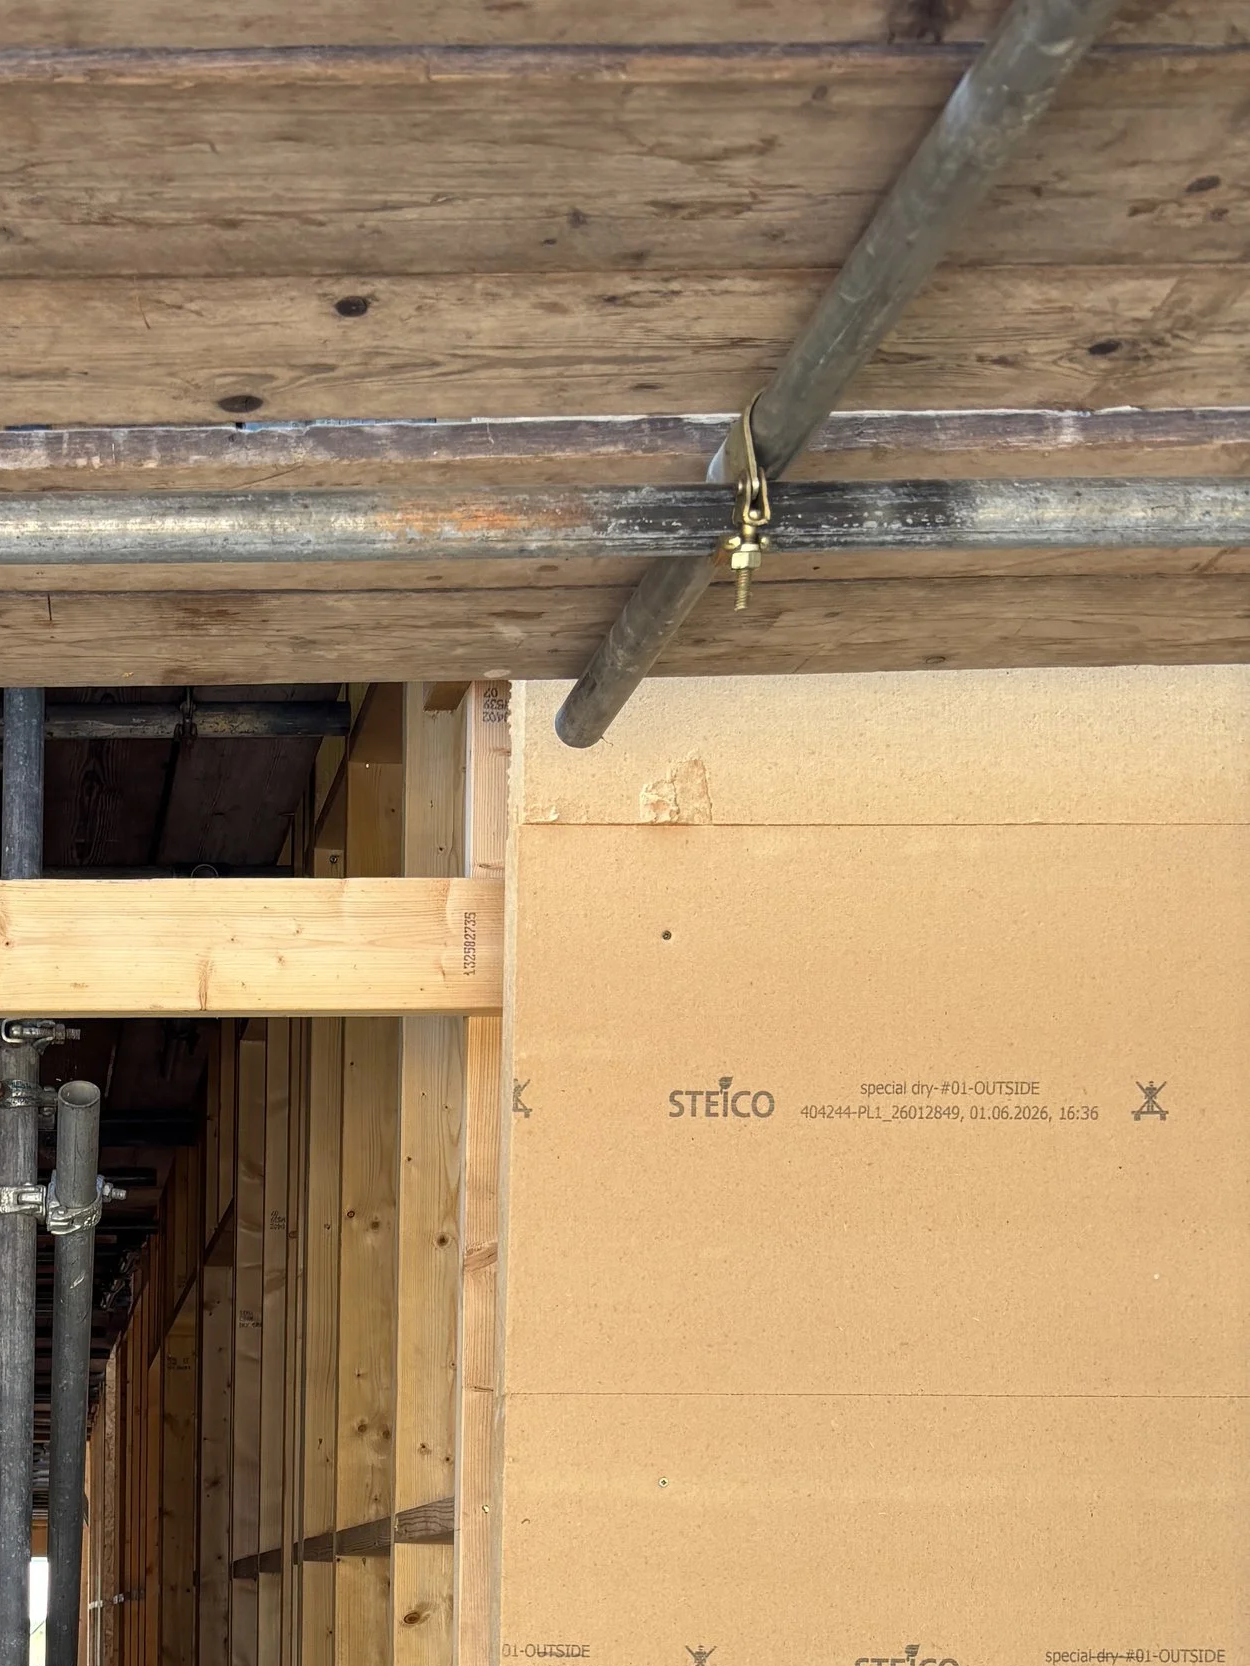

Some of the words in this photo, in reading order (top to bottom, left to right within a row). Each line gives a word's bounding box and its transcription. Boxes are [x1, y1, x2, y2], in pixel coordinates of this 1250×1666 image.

[668, 1075, 776, 1119] STEICO
[860, 1081, 907, 1098] special
[911, 1080, 1040, 1098] dry-#01-OUTSIDE
[800, 1104, 965, 1123] 404244-PL1_26012849,
[969, 1105, 1053, 1123] 01.06.2026,
[1059, 1105, 1099, 1121] 16:36
[1045, 1648, 1091, 1664] special
[1096, 1647, 1226, 1665] dry-#01-OUTSIDE
